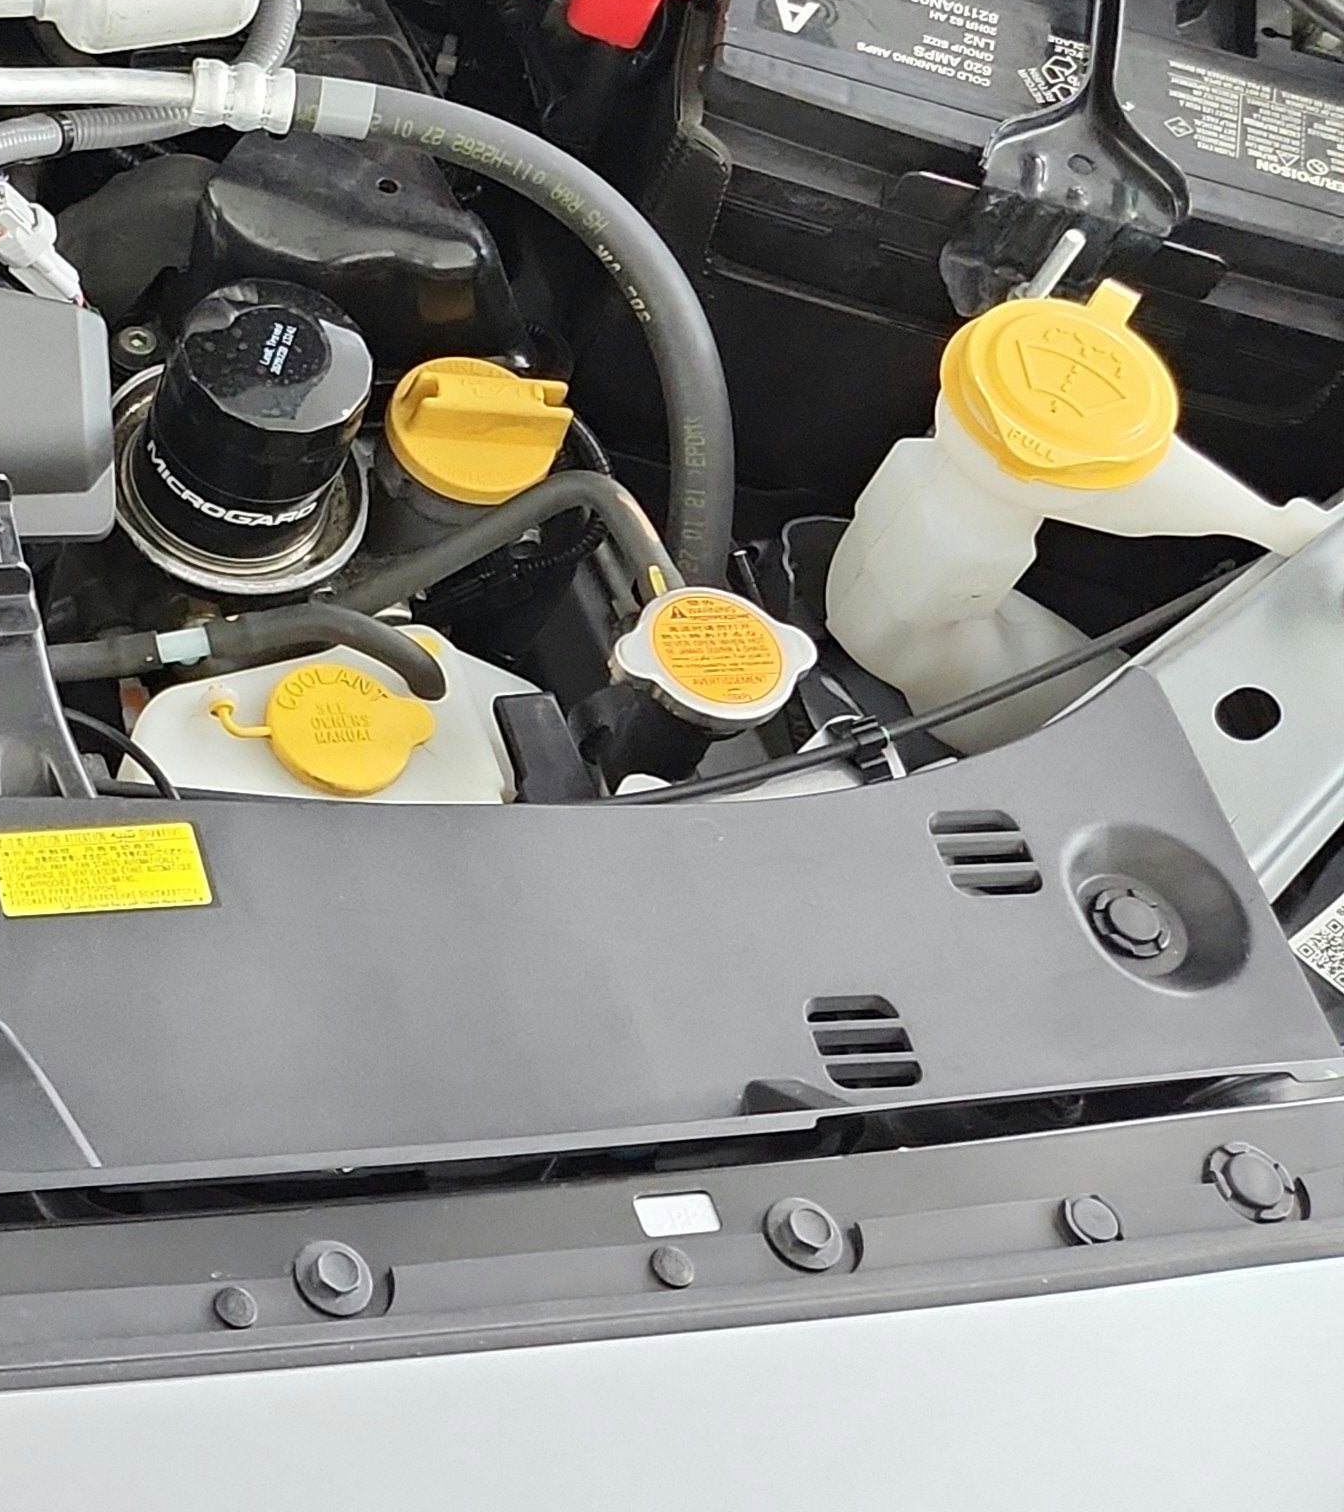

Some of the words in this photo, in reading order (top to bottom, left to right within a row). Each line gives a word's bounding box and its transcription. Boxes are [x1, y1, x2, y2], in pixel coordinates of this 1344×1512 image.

[929, 10, 949, 22] AH
[965, 20, 998, 36] 20HR
[856, 41, 892, 59] AMPS
[922, 35, 950, 49] SIZE
[963, 33, 996, 51] LN2
[913, 45, 962, 67] AMPS
[950, 43, 994, 62] GROUP
[893, 52, 956, 77] CRANKING
[963, 59, 993, 76] 620
[956, 70, 991, 87] COLD
[1017, 69, 1047, 104] RETOUR
[392, 117, 413, 138] 01
[421, 125, 445, 145] 27
[582, 210, 610, 235] HS
[1007, 428, 1055, 463] PULL
[146, 439, 318, 526] MICROGARD
[276, 669, 389, 710] COOLANT
[315, 702, 346, 715] SEE
[310, 714, 371, 729] OWNERS
[314, 729, 374, 744] MANUAL
